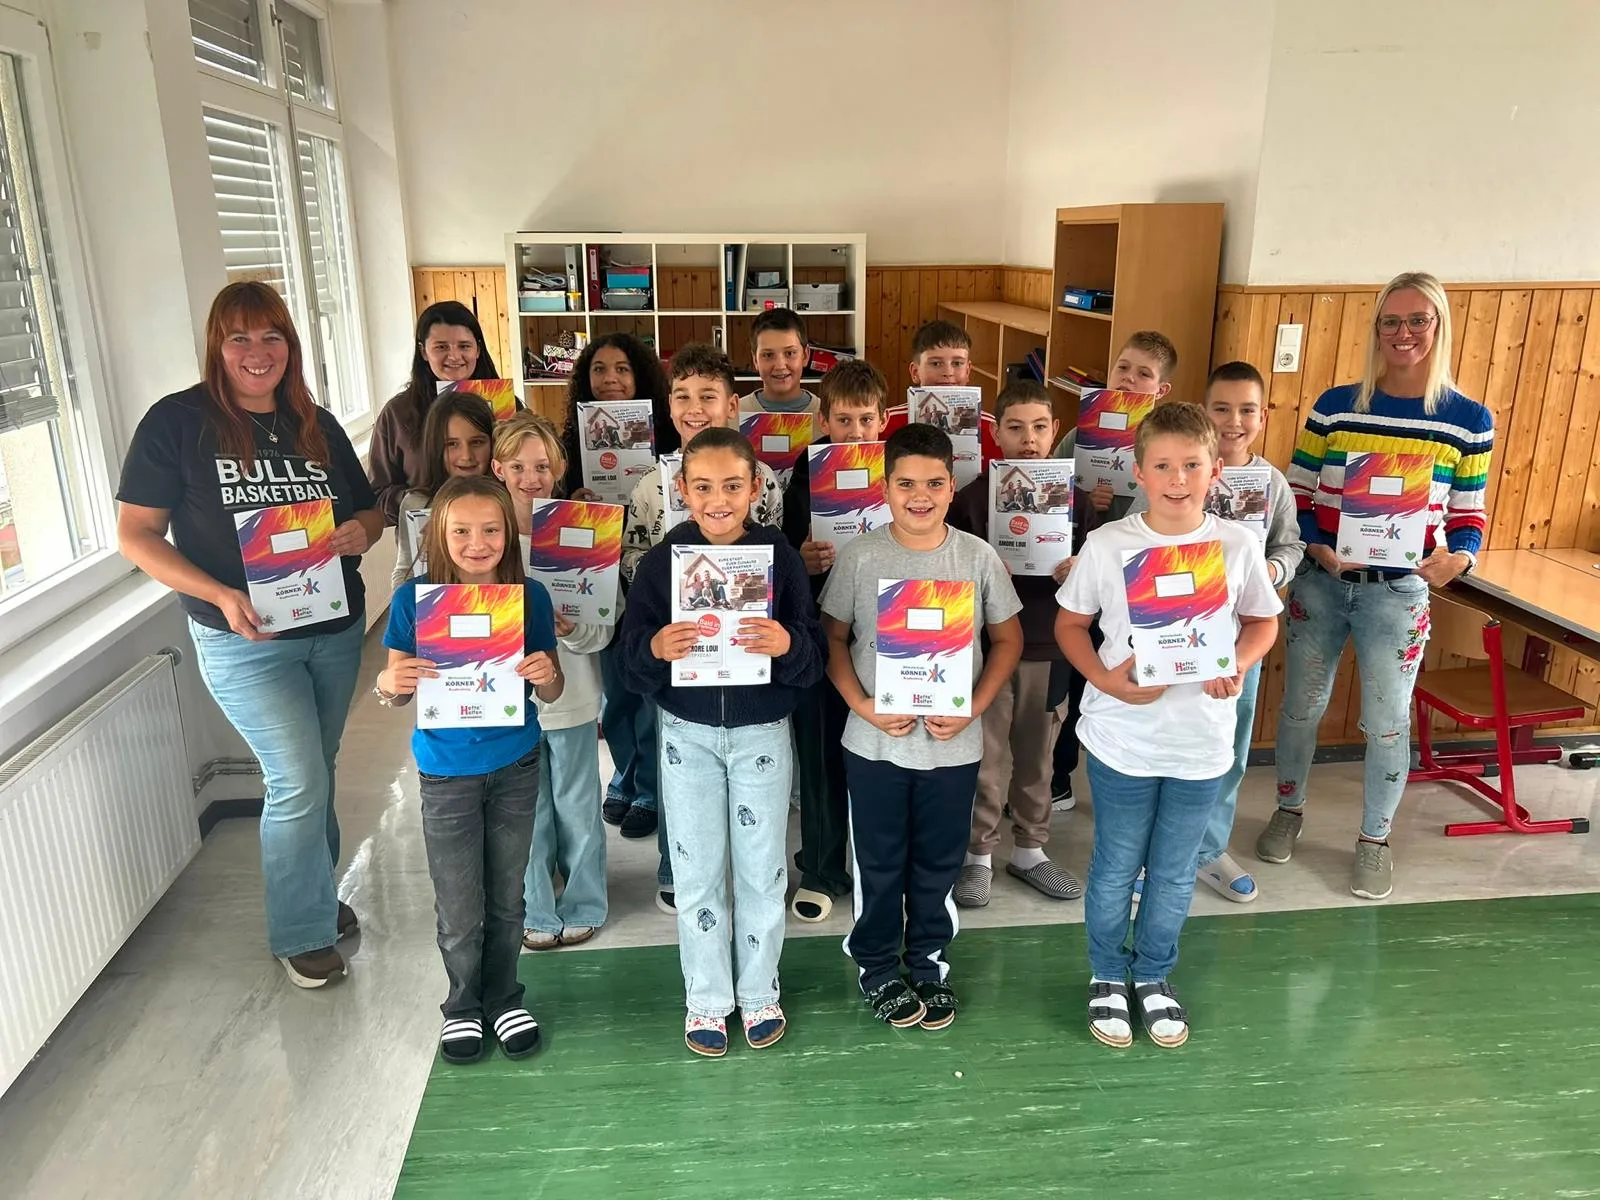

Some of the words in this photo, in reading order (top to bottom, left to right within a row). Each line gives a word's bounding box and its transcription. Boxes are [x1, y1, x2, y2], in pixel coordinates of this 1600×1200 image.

[216, 459, 328, 484] BULLS
[220, 484, 338, 504] BASKETBALL
[276, 588, 302, 596] KÖRNER
